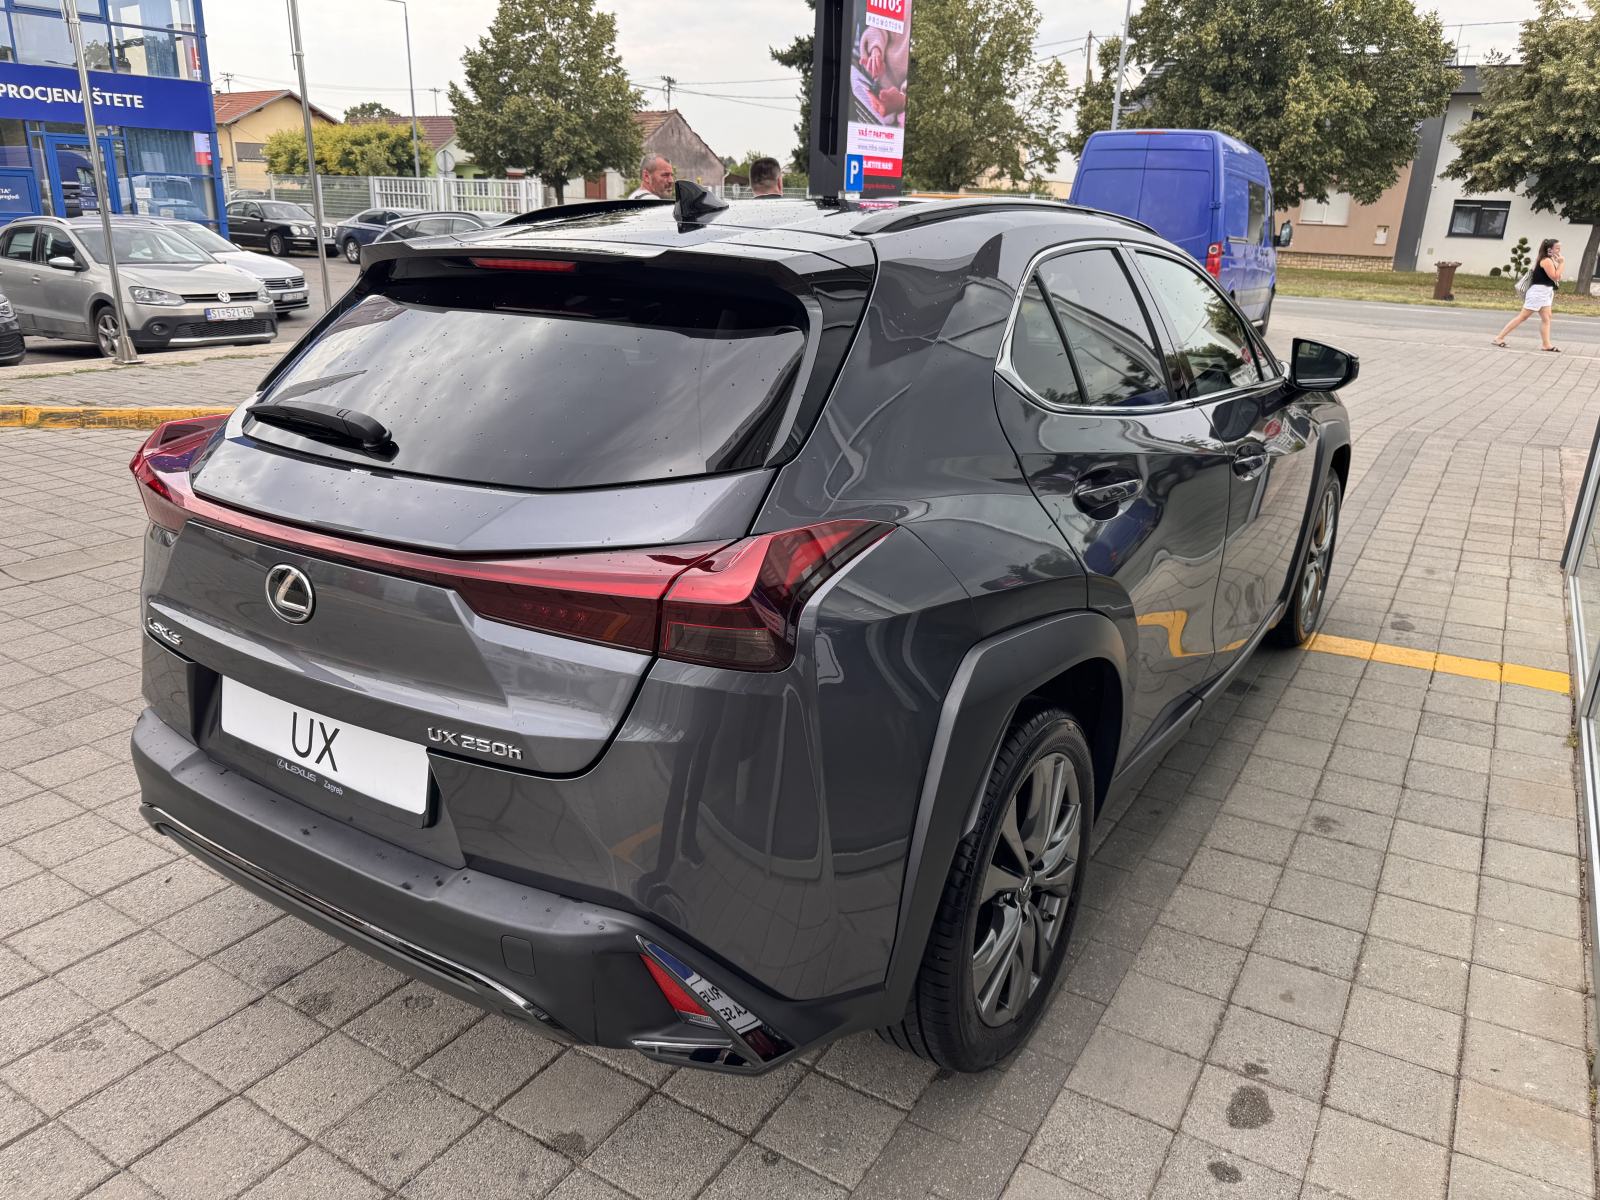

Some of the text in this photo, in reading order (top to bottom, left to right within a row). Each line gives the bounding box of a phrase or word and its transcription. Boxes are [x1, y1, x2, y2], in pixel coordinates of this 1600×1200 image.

[92, 86, 145, 109] ŠTETE
[849, 160, 860, 185] P
[291, 711, 341, 772] UX
[427, 726, 523, 761] UX 250h
[283, 761, 344, 796] LEXUS Zagreb
